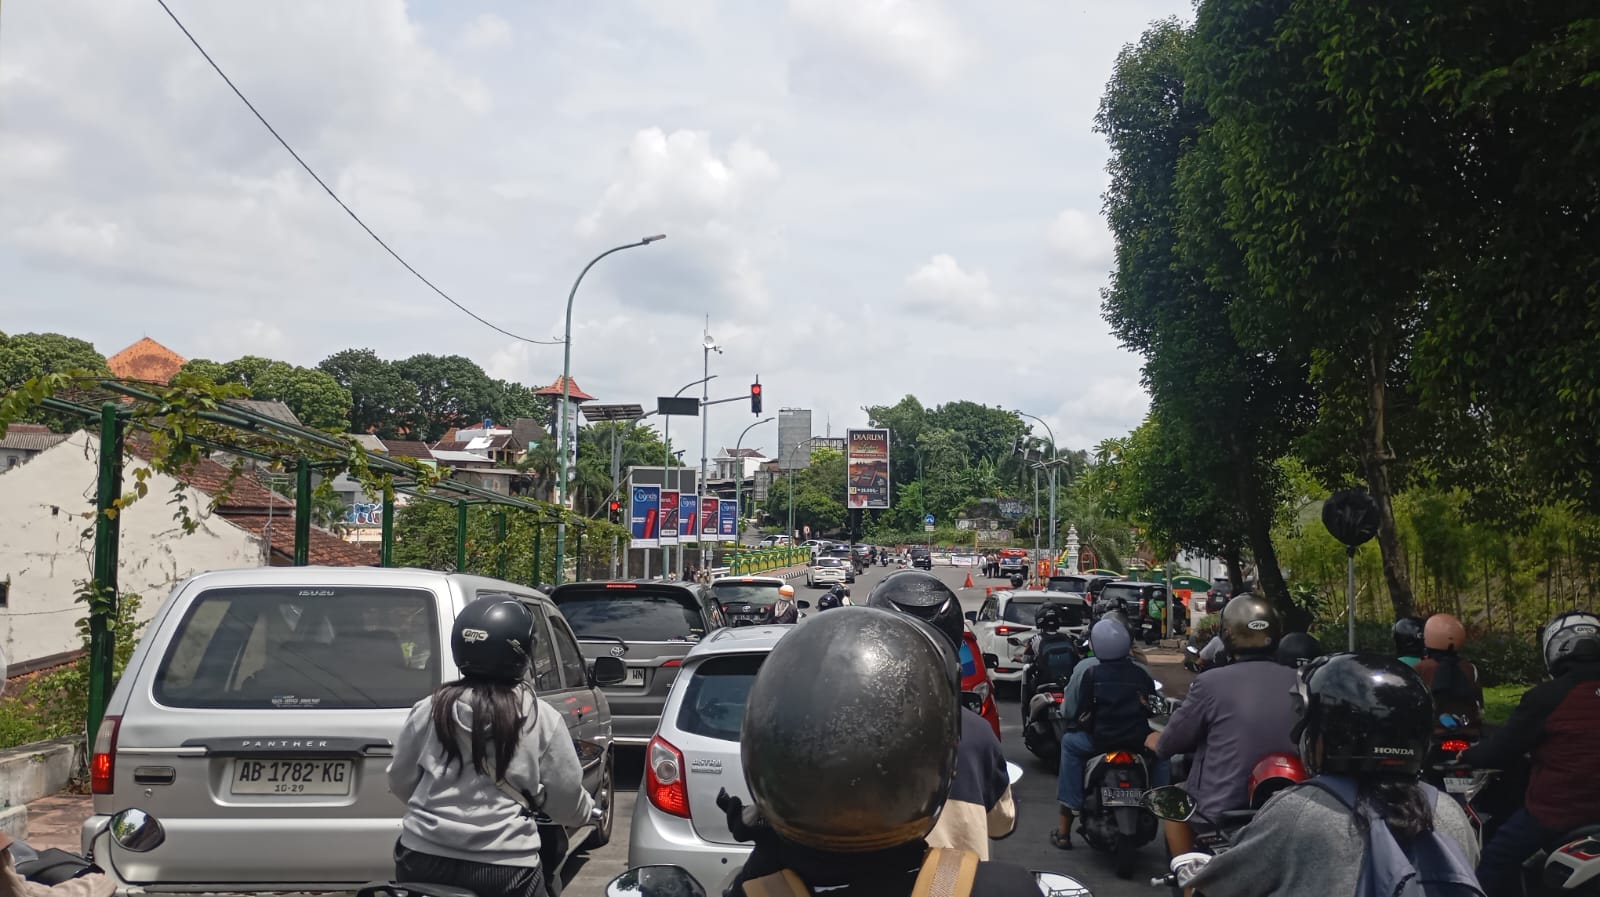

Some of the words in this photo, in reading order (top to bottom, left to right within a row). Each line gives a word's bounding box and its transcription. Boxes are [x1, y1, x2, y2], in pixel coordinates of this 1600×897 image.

[1373, 746, 1415, 756] HONDA
[239, 762, 262, 782] AB
[267, 762, 315, 783] 1782
[321, 762, 345, 783] KG
[274, 784, 305, 793] 10-29
